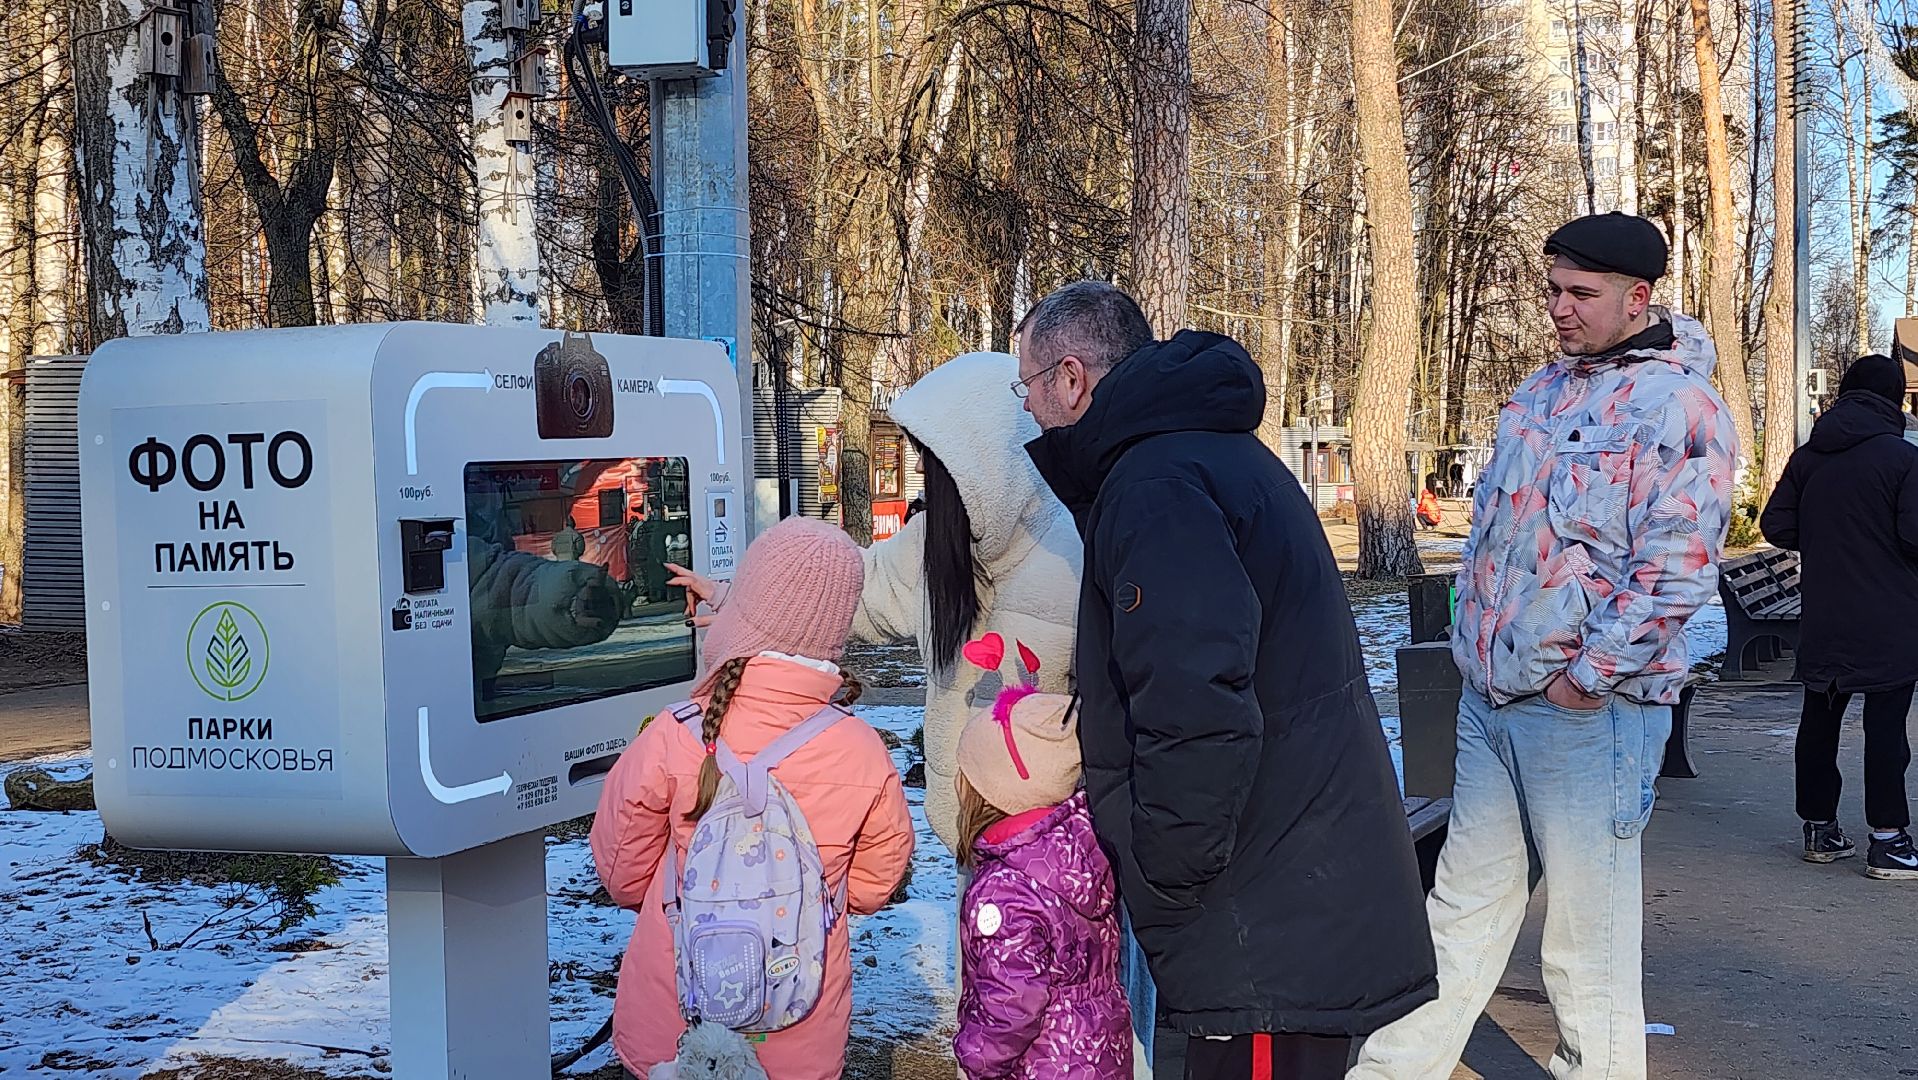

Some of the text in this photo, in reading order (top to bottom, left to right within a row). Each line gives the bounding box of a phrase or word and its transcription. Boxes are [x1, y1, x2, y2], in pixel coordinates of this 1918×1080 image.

[494, 374, 655, 394] СЕЛФИ КАМЕРА
[128, 430, 313, 492] ФОТО
[399, 485, 434, 501] 100руб.
[199, 501, 245, 531] НА
[155, 540, 295, 573] ПАМЯТЬ
[711, 546, 734, 556] ОПЛАТА
[712, 557, 734, 568] КАРТОЙ
[414, 599, 439, 609] ОПЛАТА
[414, 608, 455, 620] НАЛИЧНЫМИ
[415, 619, 453, 630] БЕЗ СДАЧИ
[187, 717, 273, 741] ПАРКИ
[132, 745, 334, 772] ПОДМОСКОВЬЯ
[564, 738, 628, 761] ВАШИ ФОТО ЗДЕСЬ
[770, 960, 797, 975] LOVELY
